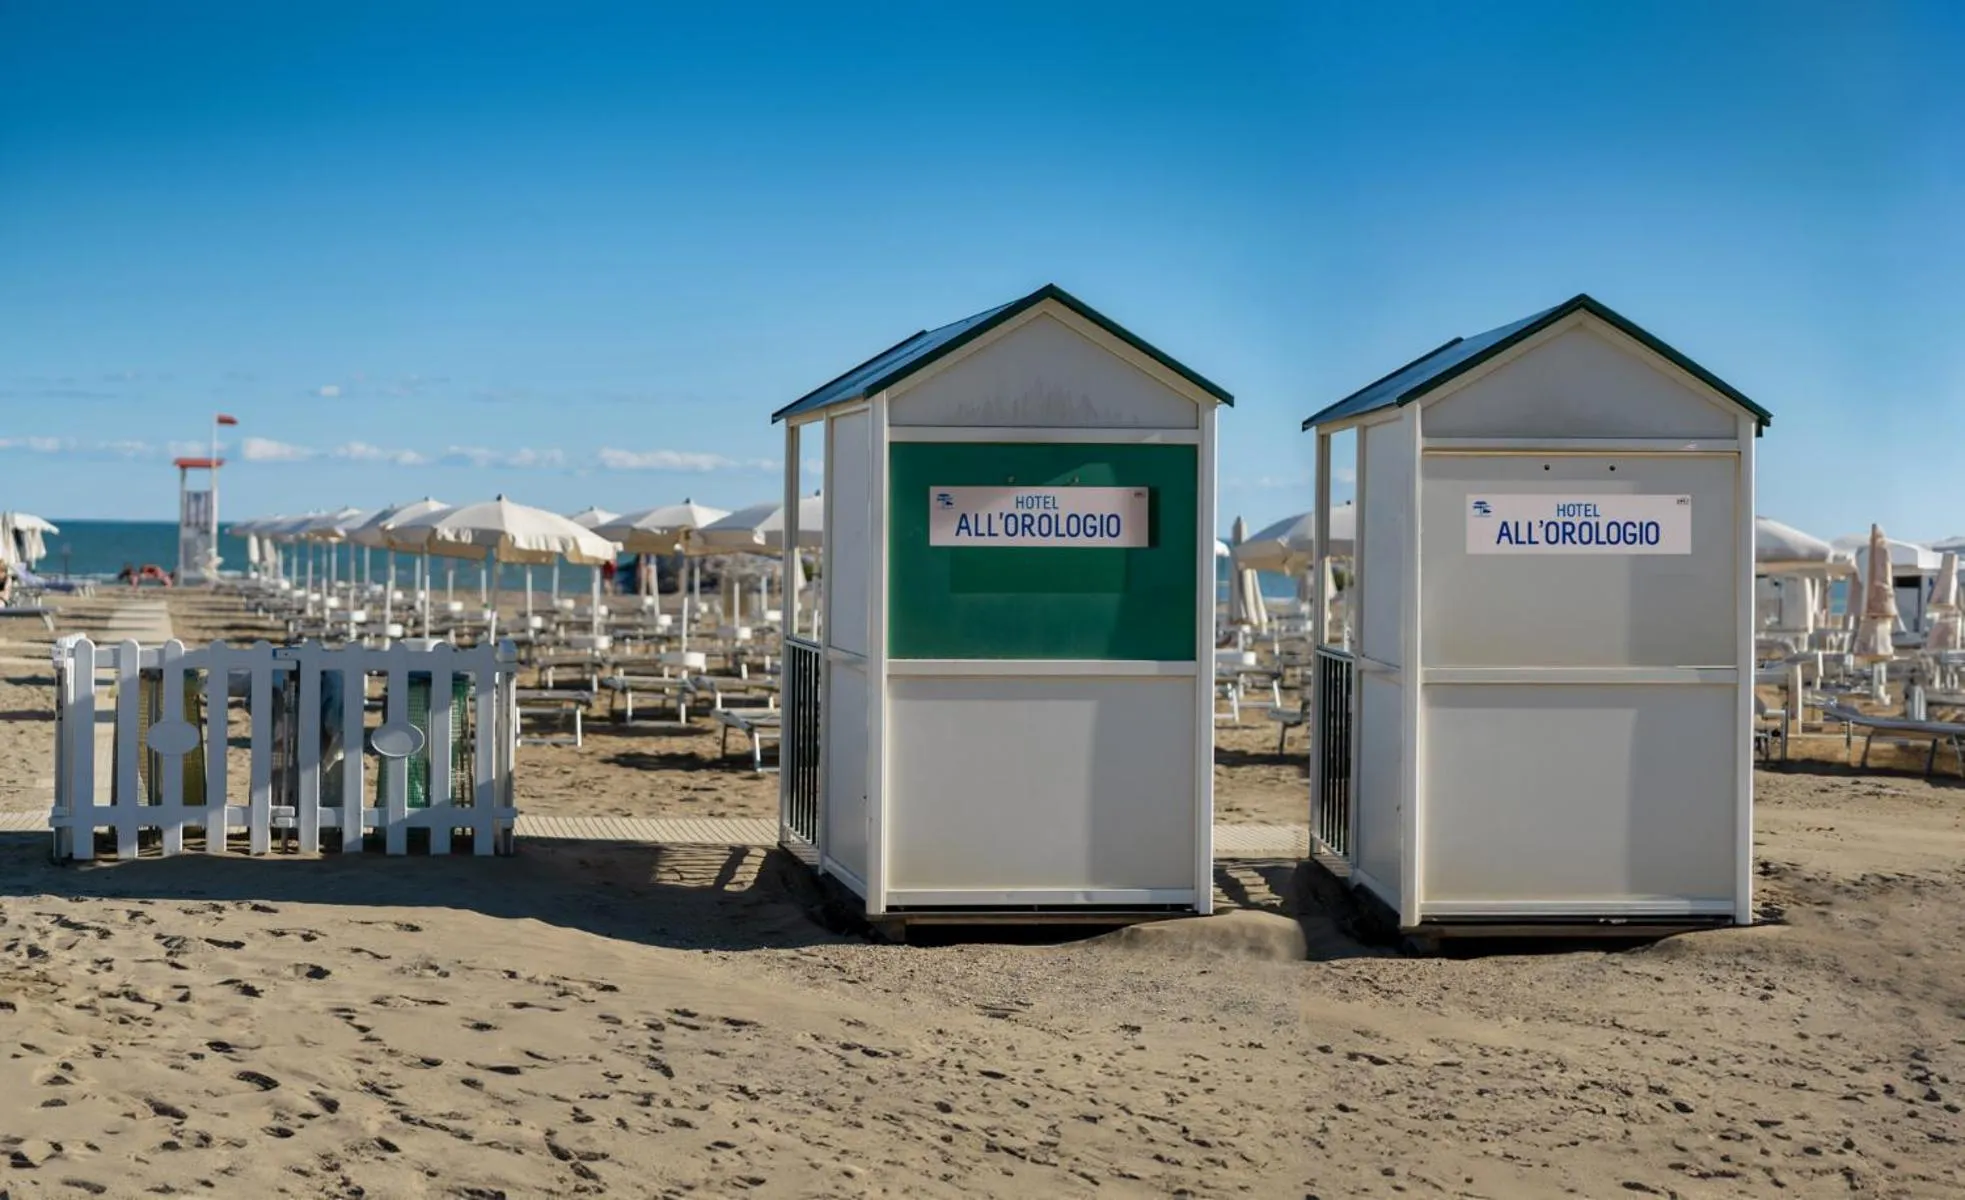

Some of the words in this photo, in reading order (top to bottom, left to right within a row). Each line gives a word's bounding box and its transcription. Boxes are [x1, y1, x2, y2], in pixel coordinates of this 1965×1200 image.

[1015, 495, 1059, 510] HOTEL
[1556, 503, 1600, 518] HOTEL
[955, 512, 1121, 538] ALL'OROLOGIO
[1496, 520, 1660, 546] ALL'OROLOGIO
